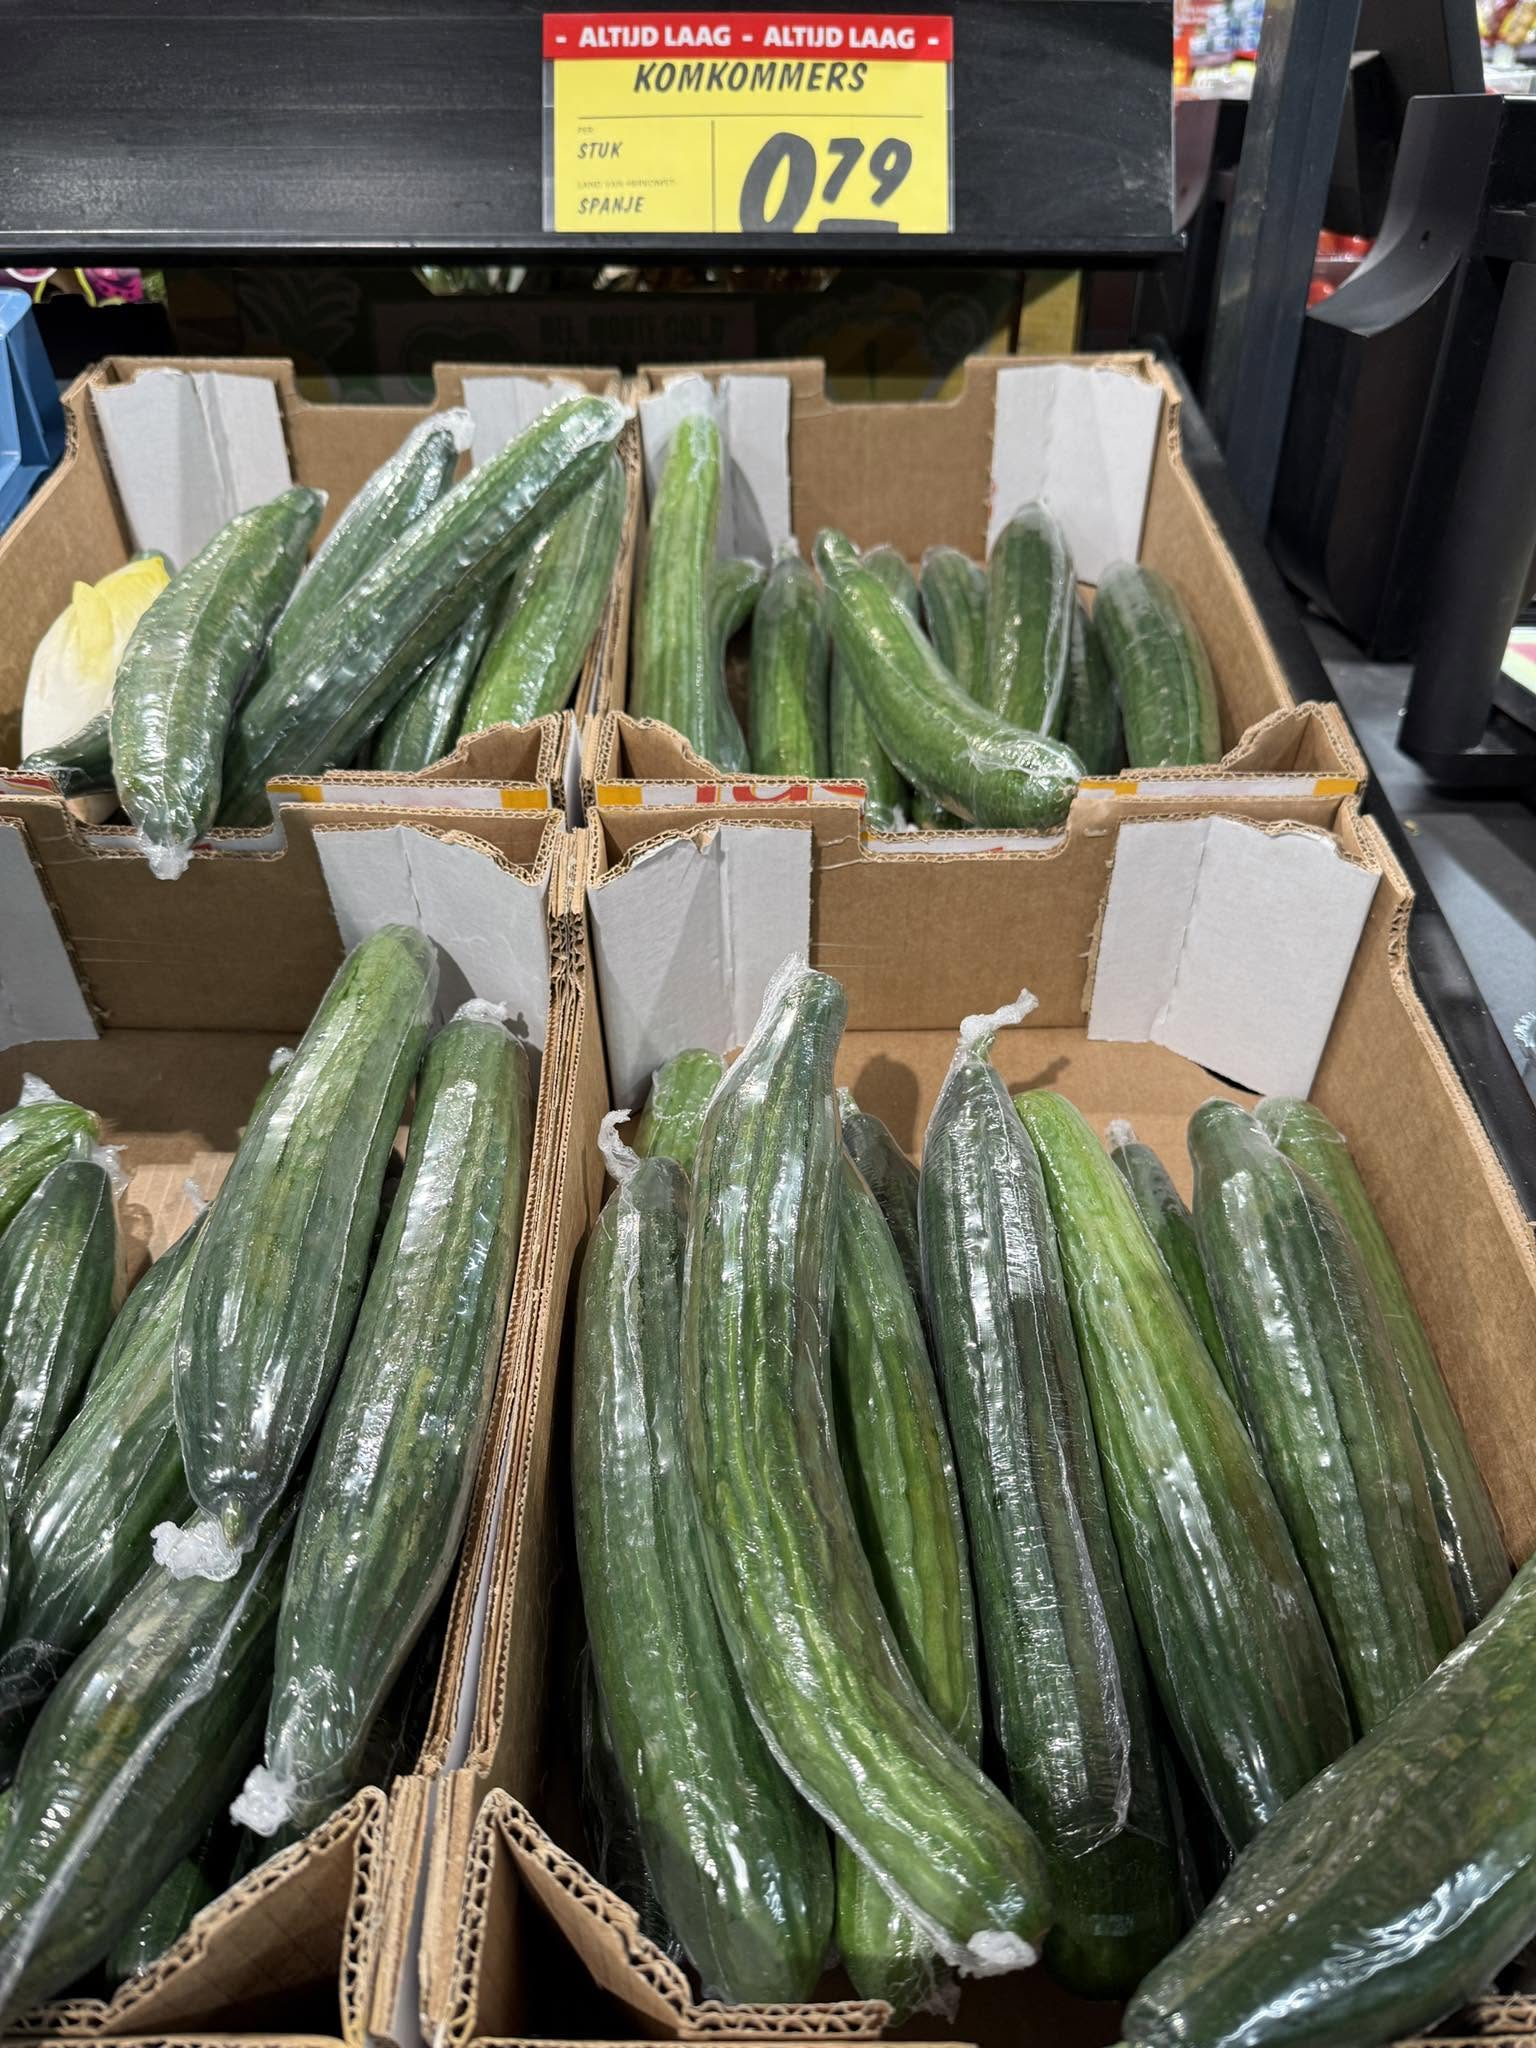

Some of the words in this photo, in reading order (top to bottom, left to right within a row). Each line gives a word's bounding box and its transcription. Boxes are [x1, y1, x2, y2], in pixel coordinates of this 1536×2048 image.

[578, 26, 659, 48] ALTIJD
[664, 26, 731, 47] LAAG
[763, 26, 844, 48] ALTIJD
[849, 27, 916, 49] LAAG
[633, 61, 868, 93] KOMKOMMERS
[577, 141, 623, 159] STUK
[577, 196, 645, 215] SPANJE
